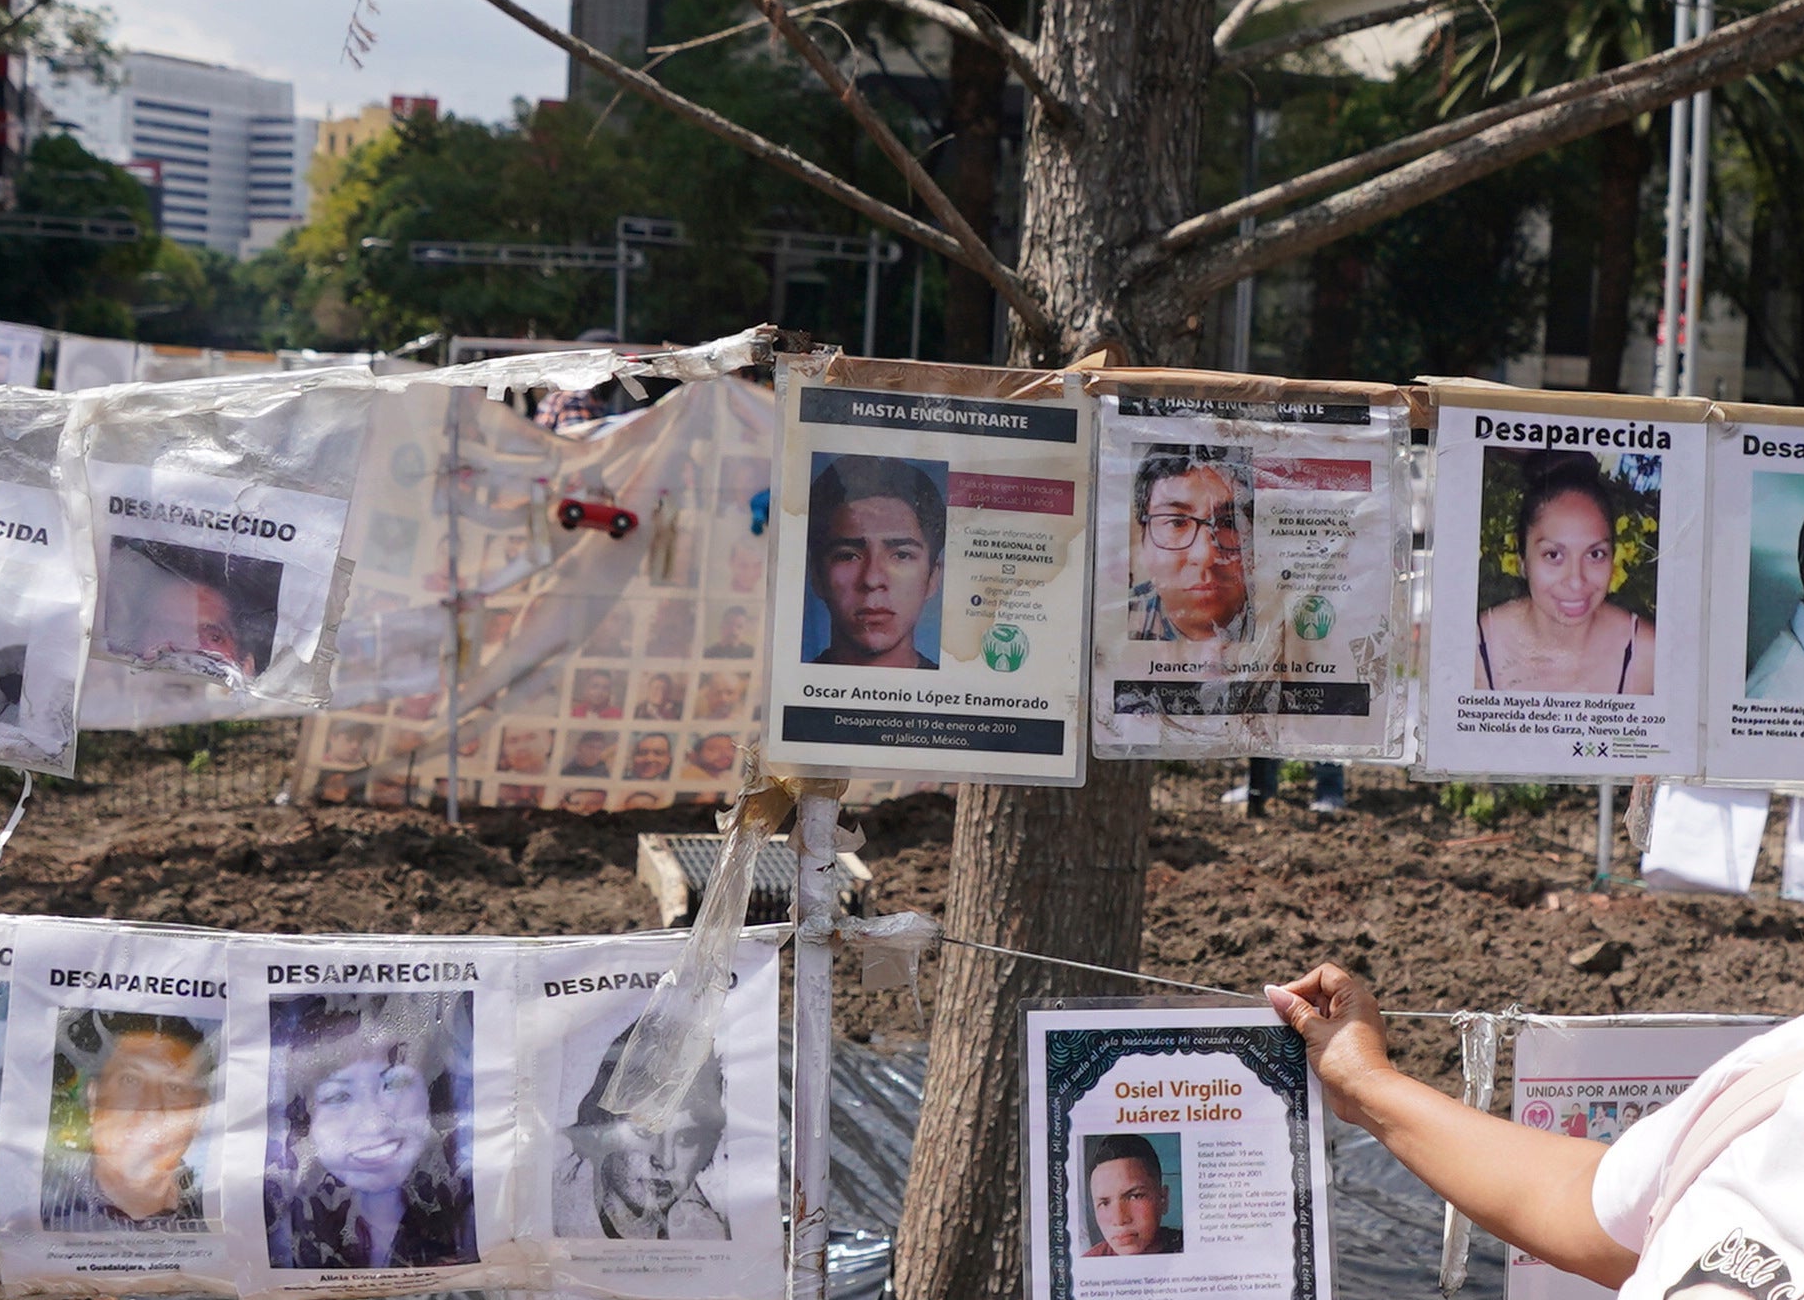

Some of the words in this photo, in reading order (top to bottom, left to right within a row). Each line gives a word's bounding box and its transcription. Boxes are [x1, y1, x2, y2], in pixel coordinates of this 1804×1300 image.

[852, 402, 905, 420] HASTA
[910, 407, 1028, 429] ENCONTRARTE
[1475, 415, 1672, 452] Desaparecida
[109, 496, 296, 543] DESAPARECIDO
[973, 539, 989, 547] RED
[992, 540, 1033, 550] REGIONAL
[965, 551, 1003, 560] FAMILIAS
[1005, 554, 1053, 564] MIGRANTES
[803, 685, 847, 699] Oscar
[851, 687, 911, 702] Antonio
[917, 690, 960, 707] López
[965, 694, 1048, 710] Enamorado
[1458, 696, 1500, 705] Griselda
[1504, 697, 1540, 708] Mayela
[1543, 696, 1581, 708] Álvarez
[1585, 700, 1635, 711] Rodríguez
[1458, 710, 1525, 722] Desaparecida
[1528, 712, 1561, 721] desde:
[1564, 714, 1572, 722] 11
[1576, 713, 1587, 722] de
[1591, 714, 1624, 724] agosto
[1627, 714, 1638, 723] de
[1642, 716, 1665, 724] 2020
[1732, 705, 1748, 714] Roy
[1751, 705, 1777, 713] Rivera
[835, 715, 902, 729] Desaparecido
[905, 719, 914, 728] el
[917, 720, 929, 729] 19
[931, 720, 944, 730] de
[947, 724, 974, 732] enero
[977, 723, 990, 732] de
[992, 724, 1016, 733] 2010
[1457, 723, 1475, 732] San
[1479, 723, 1516, 733] Nicolás
[1520, 724, 1531, 733] de
[1535, 724, 1548, 734] los
[1552, 726, 1585, 736] Garza,
[1588, 726, 1620, 736] Nuevo
[1623, 727, 1647, 737] León
[895, 734, 930, 745] Jalisco,
[932, 735, 970, 746] México.
[267, 961, 479, 986] DESAPARECIDA
[1115, 1081, 1164, 1099] Osiel
[1169, 1080, 1243, 1103] Virgilio
[1527, 1086, 1573, 1098] UNIDAS
[1577, 1085, 1603, 1097] POR
[1608, 1085, 1648, 1096] AMOR
[1653, 1084, 1661, 1095] A
[1116, 1106, 1180, 1124] Juárez
[1187, 1105, 1242, 1123] Isidro
[1699, 1227, 1785, 1288] Osiel
